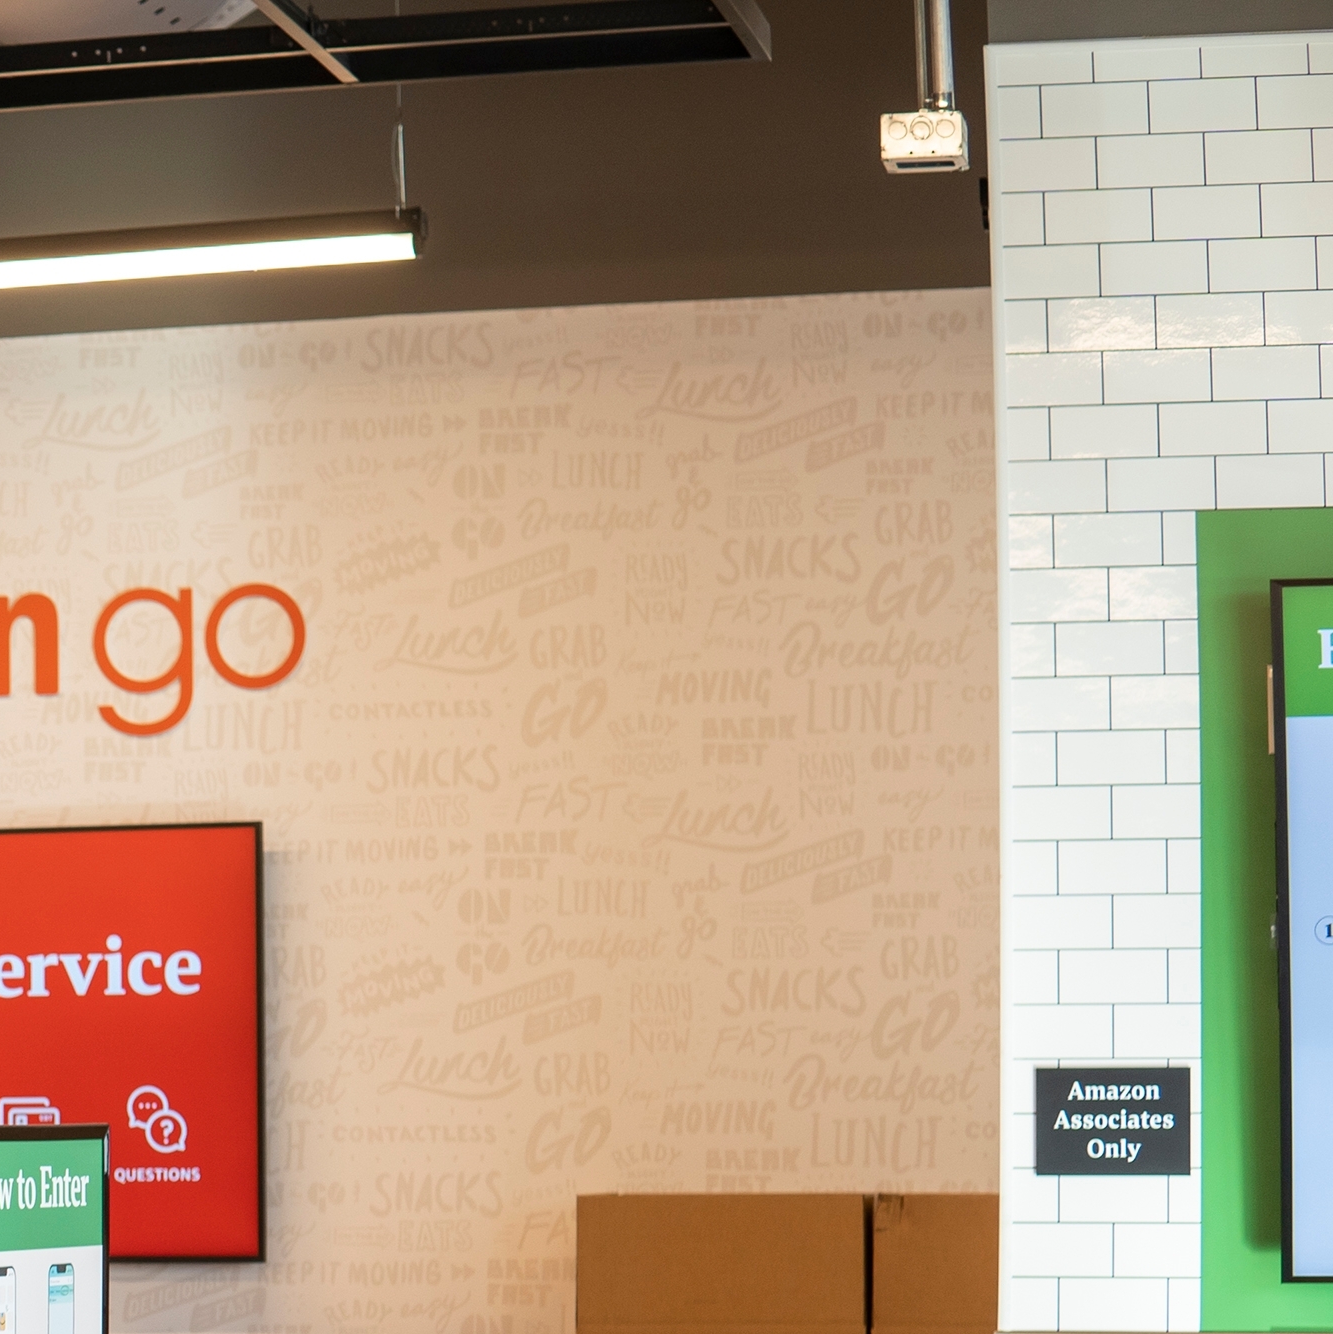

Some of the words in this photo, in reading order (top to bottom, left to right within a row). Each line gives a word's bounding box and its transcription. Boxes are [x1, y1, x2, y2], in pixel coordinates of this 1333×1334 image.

[718, 534, 862, 585] SNACKS
[92, 581, 307, 738] go
[779, 621, 974, 678] Breakfast
[1068, 1080, 1161, 1101] Amazon
[1053, 1109, 1175, 1130] Associates
[1087, 1138, 1142, 1163] Only
[17, 1168, 37, 1210] to
[40, 1165, 90, 1209] Enter
[114, 1167, 201, 1183] QUESTIONS
